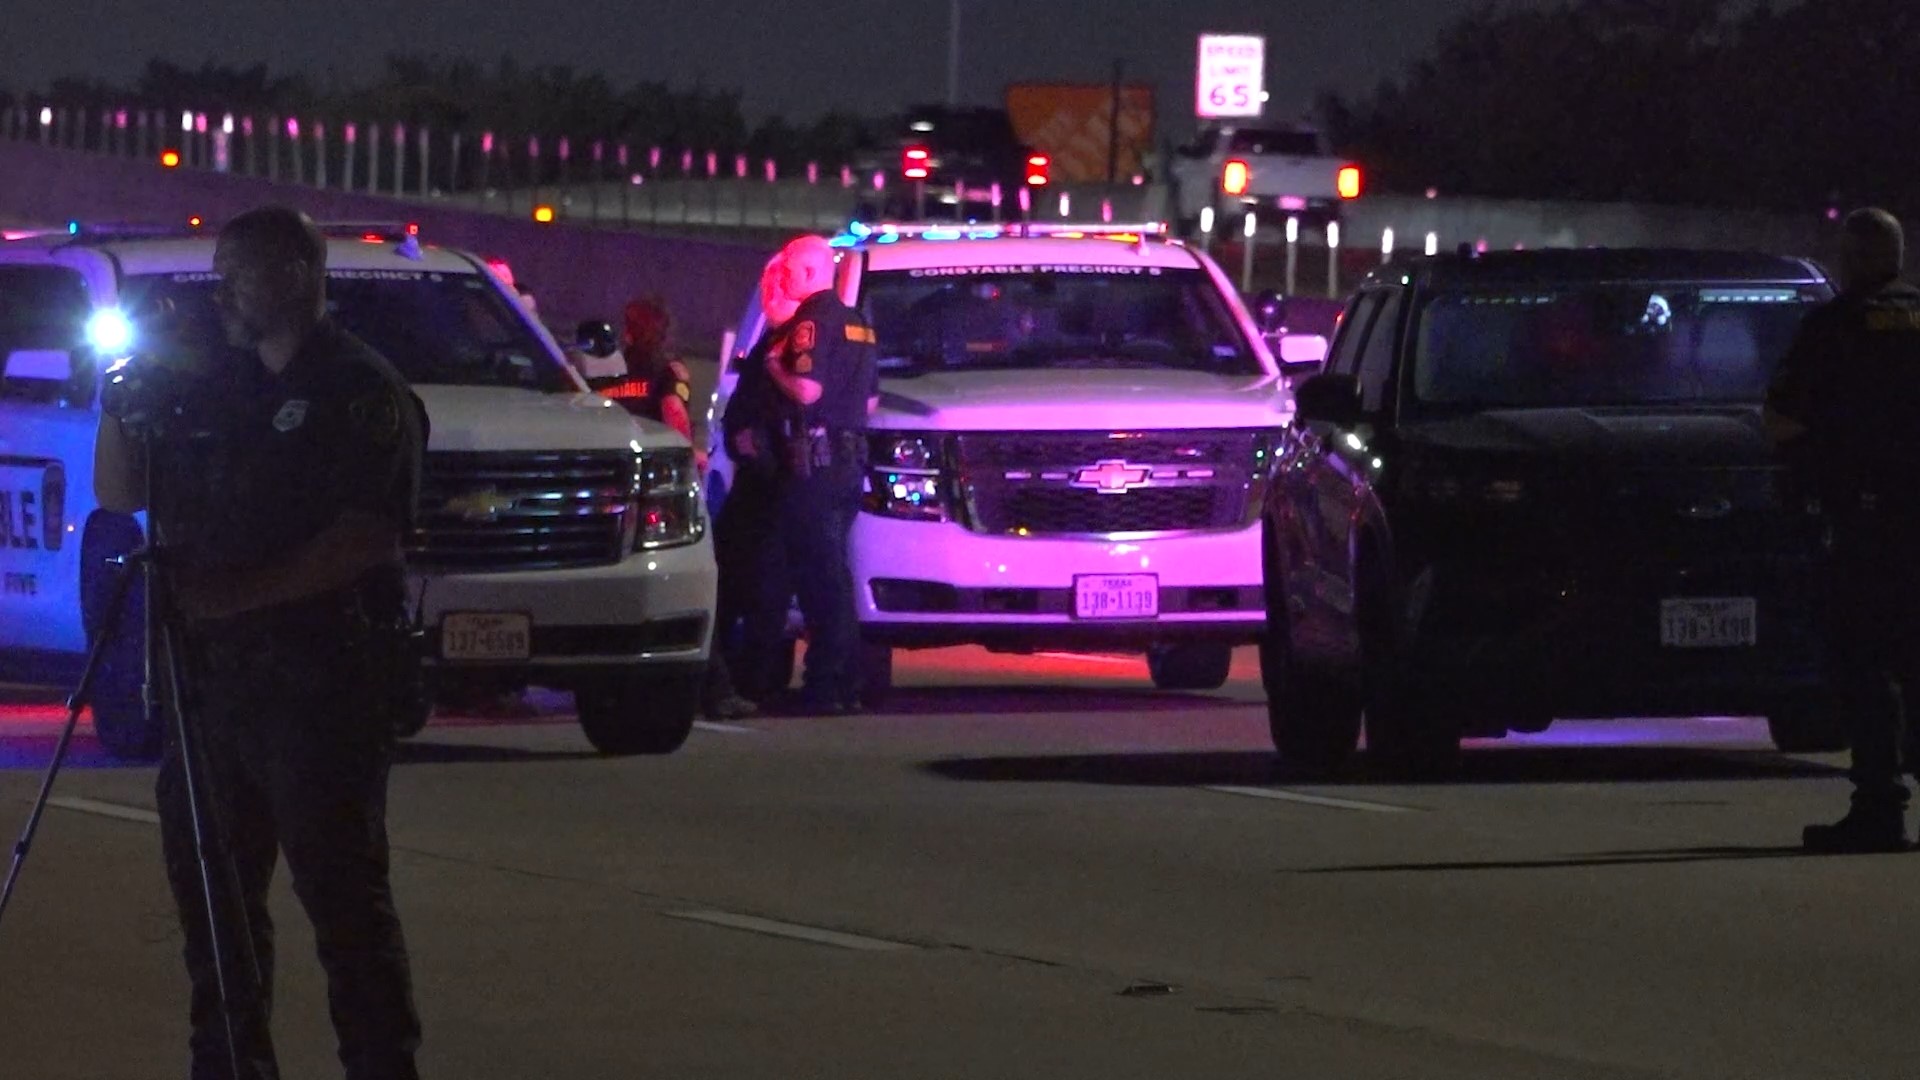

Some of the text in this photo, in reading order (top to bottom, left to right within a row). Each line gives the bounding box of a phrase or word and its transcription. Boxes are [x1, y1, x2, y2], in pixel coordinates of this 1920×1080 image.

[1209, 84, 1249, 107] 65
[325, 270, 423, 281] RECINCT
[909, 264, 1034, 278] CONSTABLE
[1040, 264, 1143, 276] PRECINCT
